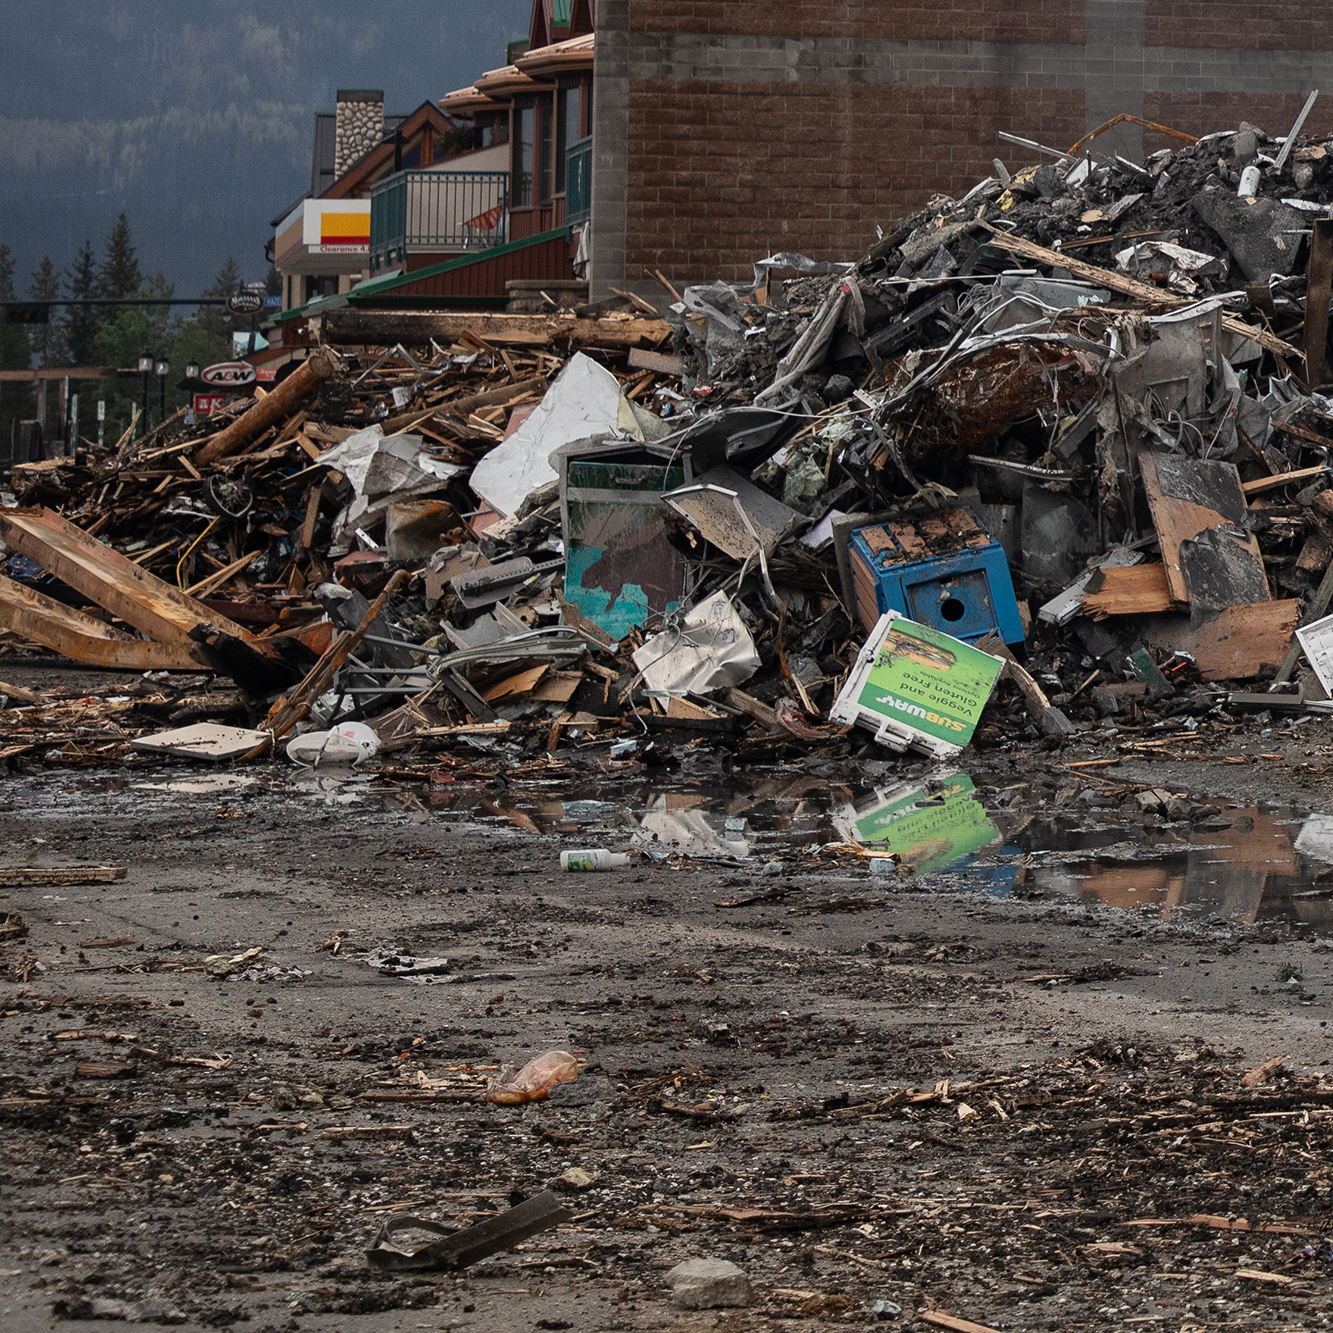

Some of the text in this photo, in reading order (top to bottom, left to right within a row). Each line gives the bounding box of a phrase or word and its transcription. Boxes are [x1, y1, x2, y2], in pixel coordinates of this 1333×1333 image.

[320, 244, 358, 253] Clearance
[210, 371, 251, 382] A&W
[899, 681, 972, 717] Veggie and
[902, 671, 977, 707] Gluten Free
[919, 670, 981, 699] Options Available
[875, 694, 968, 732] SUBWAY
